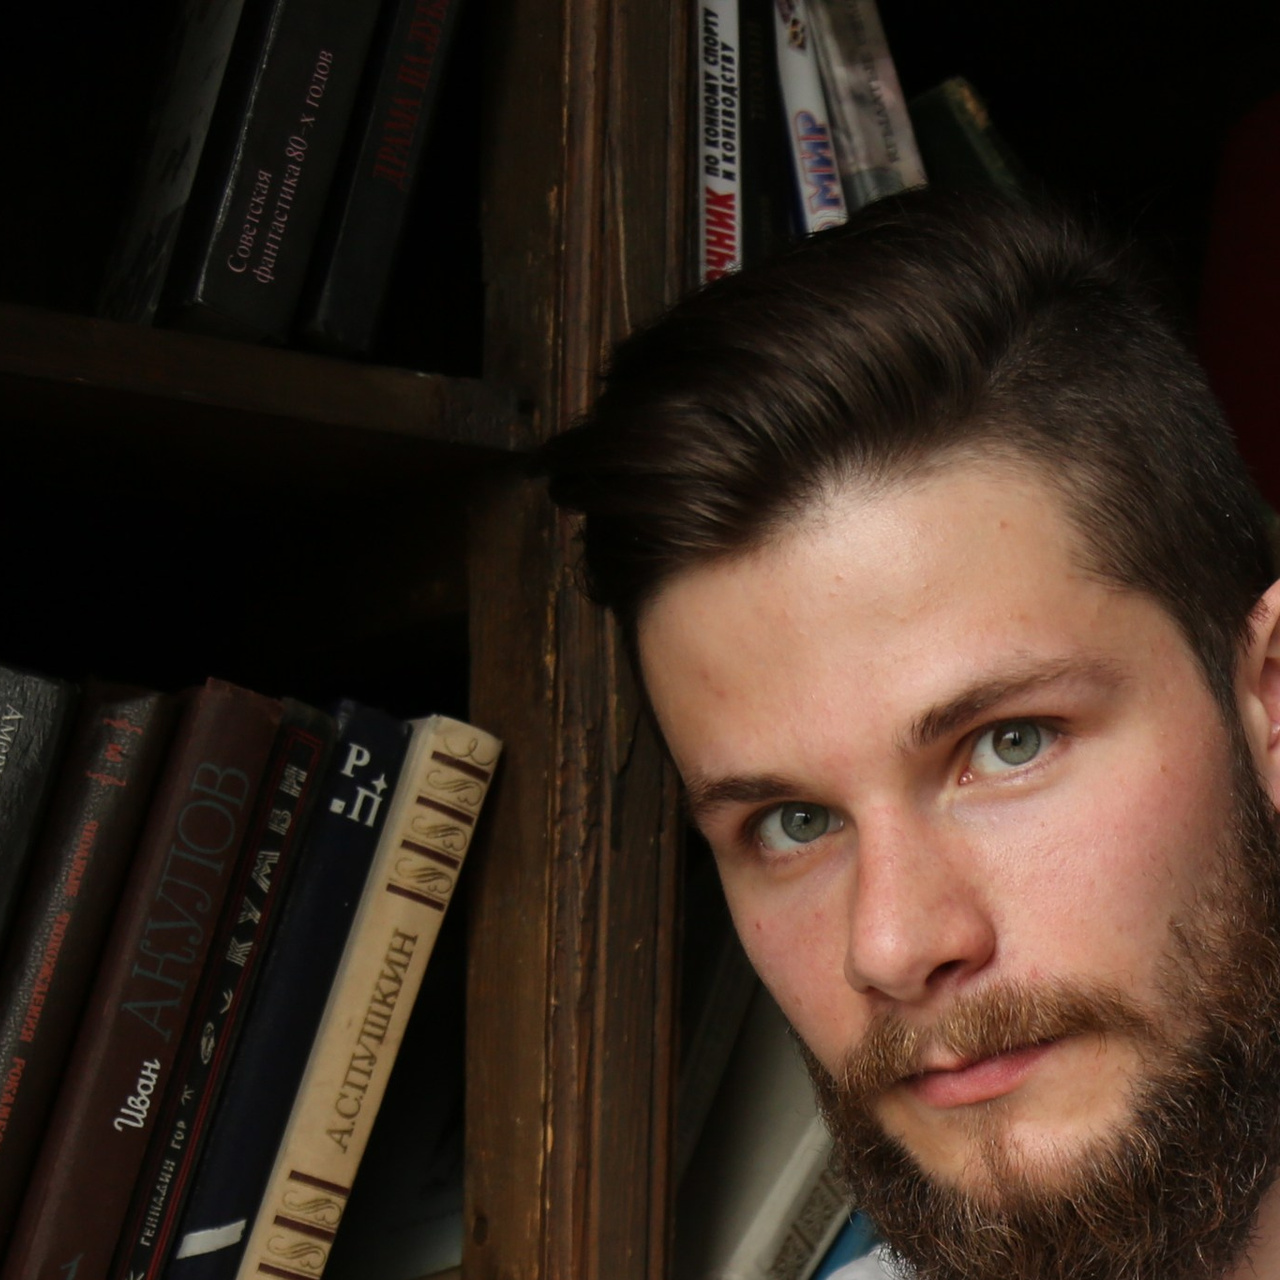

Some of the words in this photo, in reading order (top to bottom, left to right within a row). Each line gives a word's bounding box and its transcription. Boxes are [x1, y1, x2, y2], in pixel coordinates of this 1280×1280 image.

[704, 8, 719, 67] СПОРТУ
[704, 72, 720, 148] КОННОМУ
[721, 43, 737, 154] КОНЕВОДСТВУ
[254, 160, 302, 284] фантастика
[305, 49, 335, 110] годов
[704, 152, 721, 177] ПО
[721, 163, 736, 181] И
[227, 168, 273, 274] Советская
[120, 760, 250, 1042] АКУЛОВ
[19, 910, 71, 1043] ПОХОЖДЕНИЯ
[112, 1057, 161, 1134] Иван
[138, 1156, 178, 1249] ГЕННАДИЙ
[169, 1116, 188, 1152] ГОР
